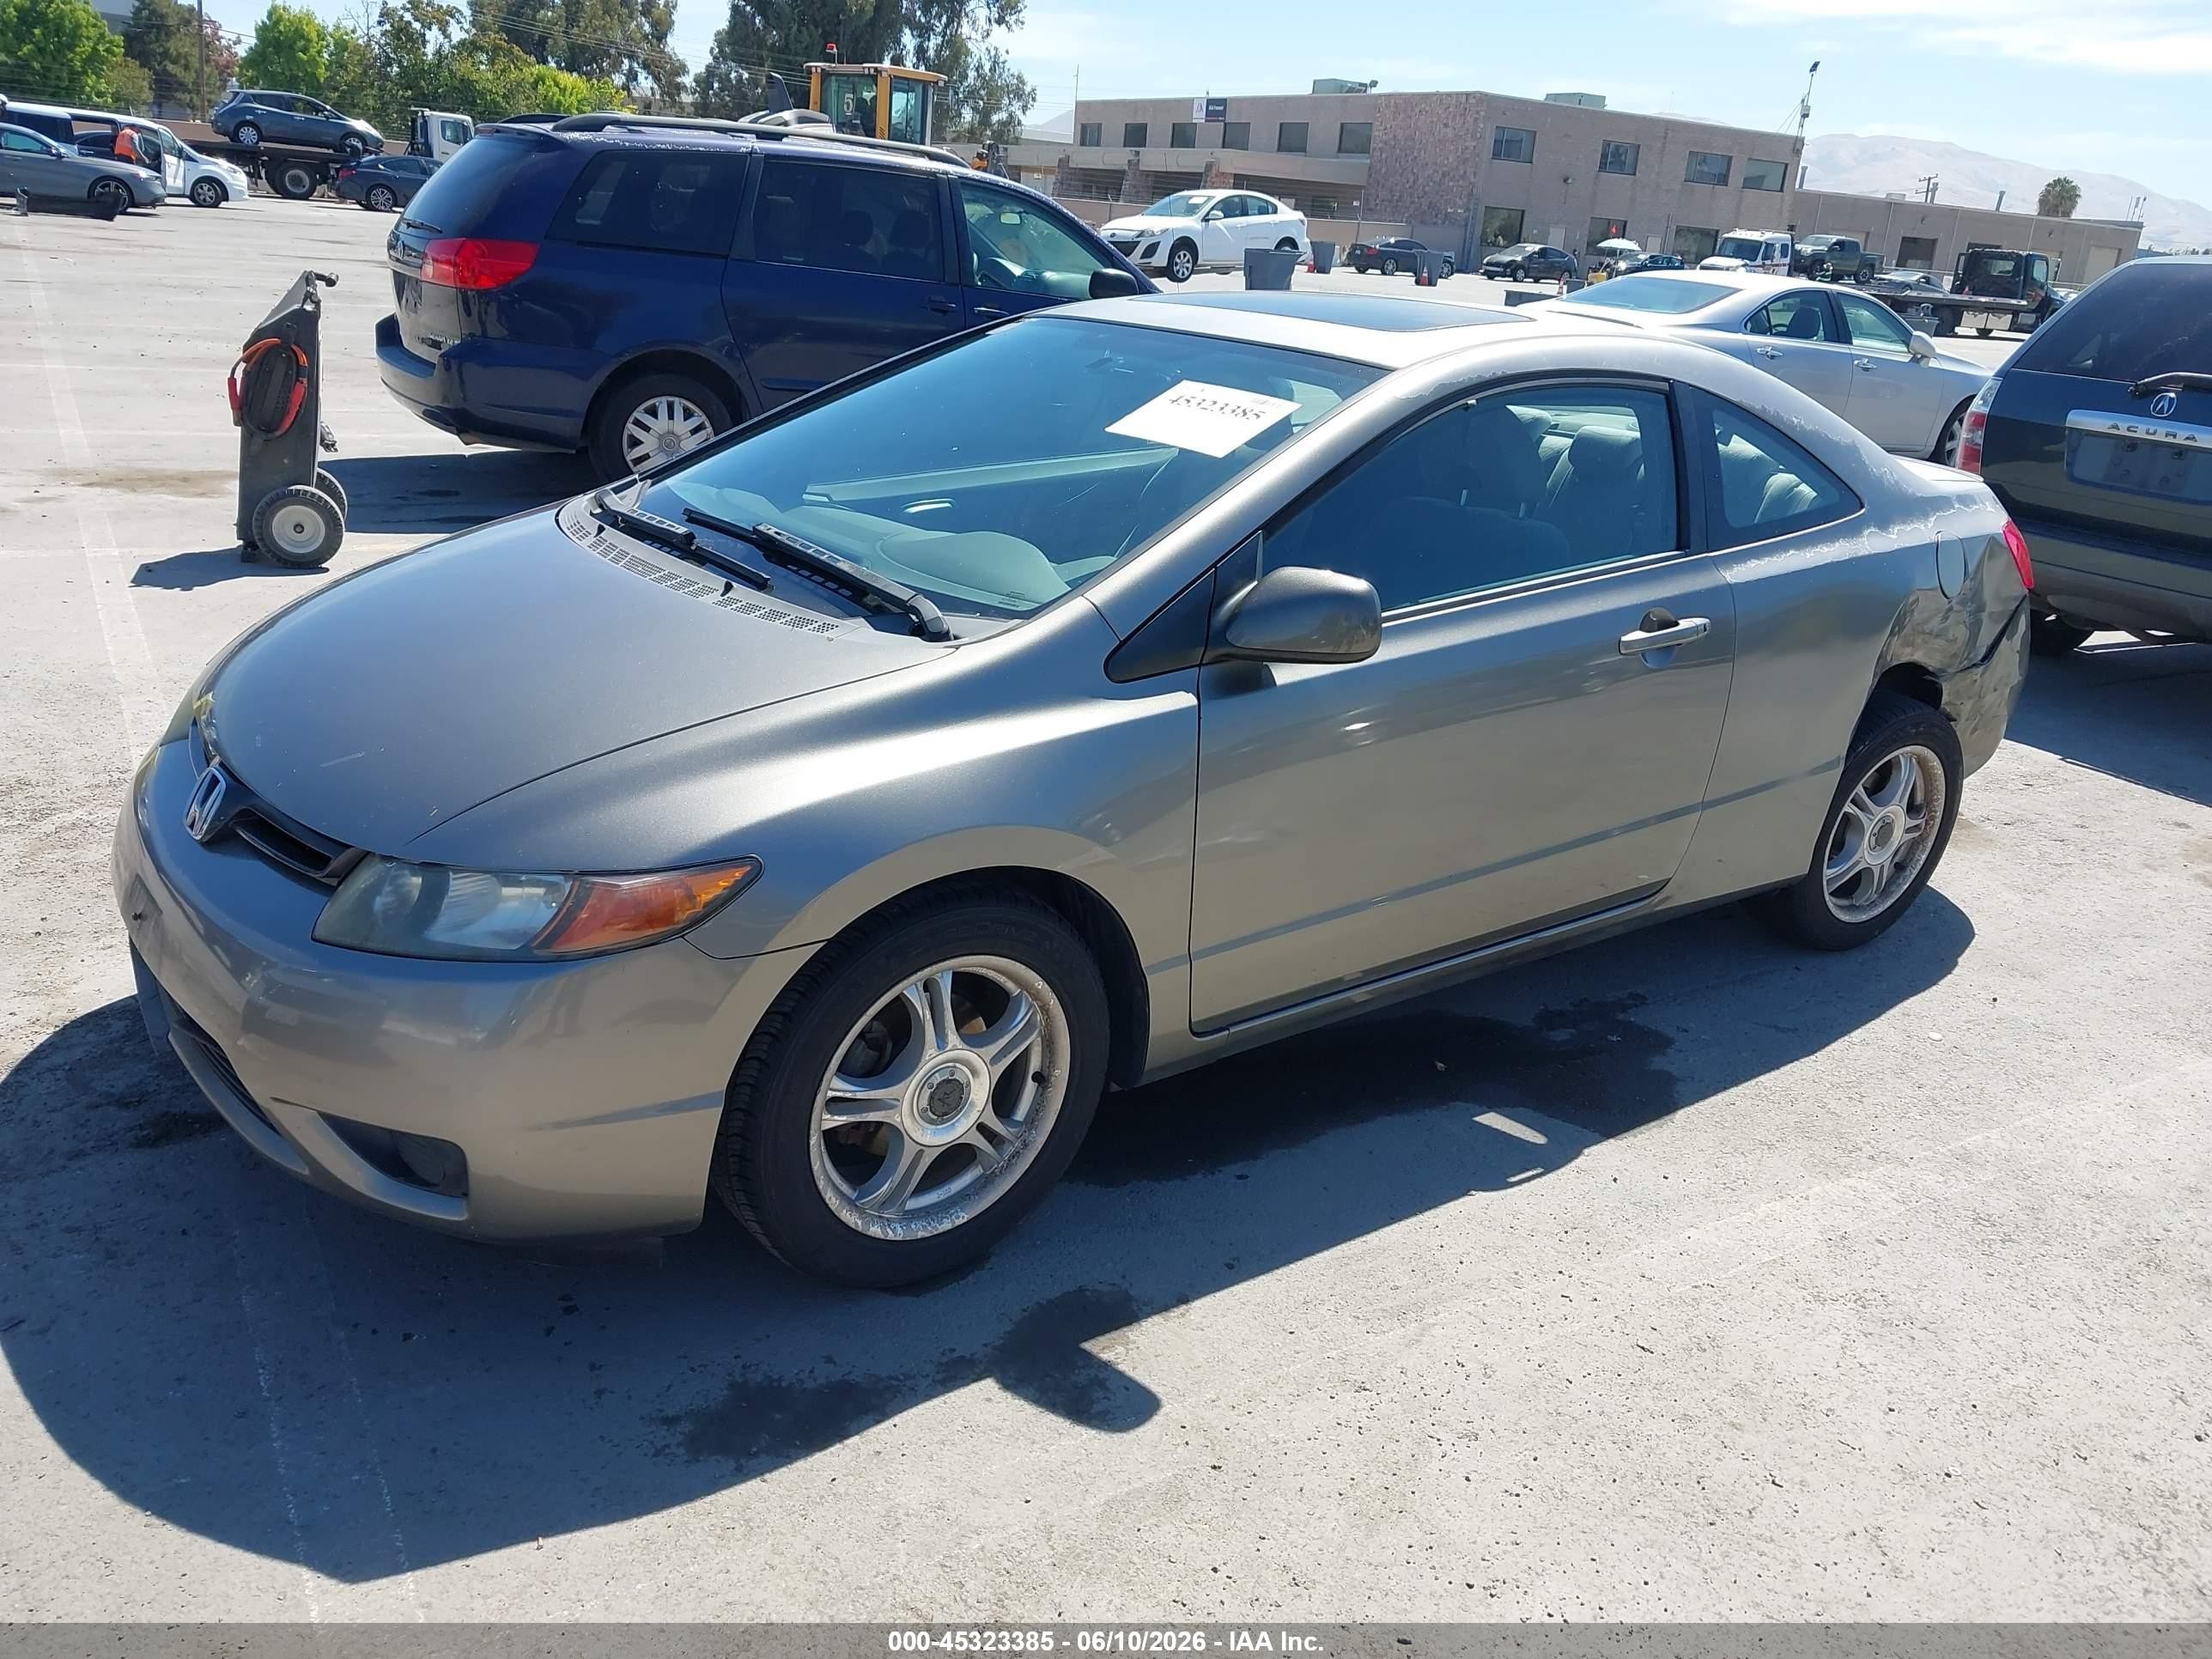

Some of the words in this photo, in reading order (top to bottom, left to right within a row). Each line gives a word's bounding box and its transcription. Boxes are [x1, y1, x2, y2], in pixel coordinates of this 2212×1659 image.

[844, 93, 854, 112] 5
[1169, 395, 1267, 420] 45323385
[2107, 422, 2198, 443] ACURA
